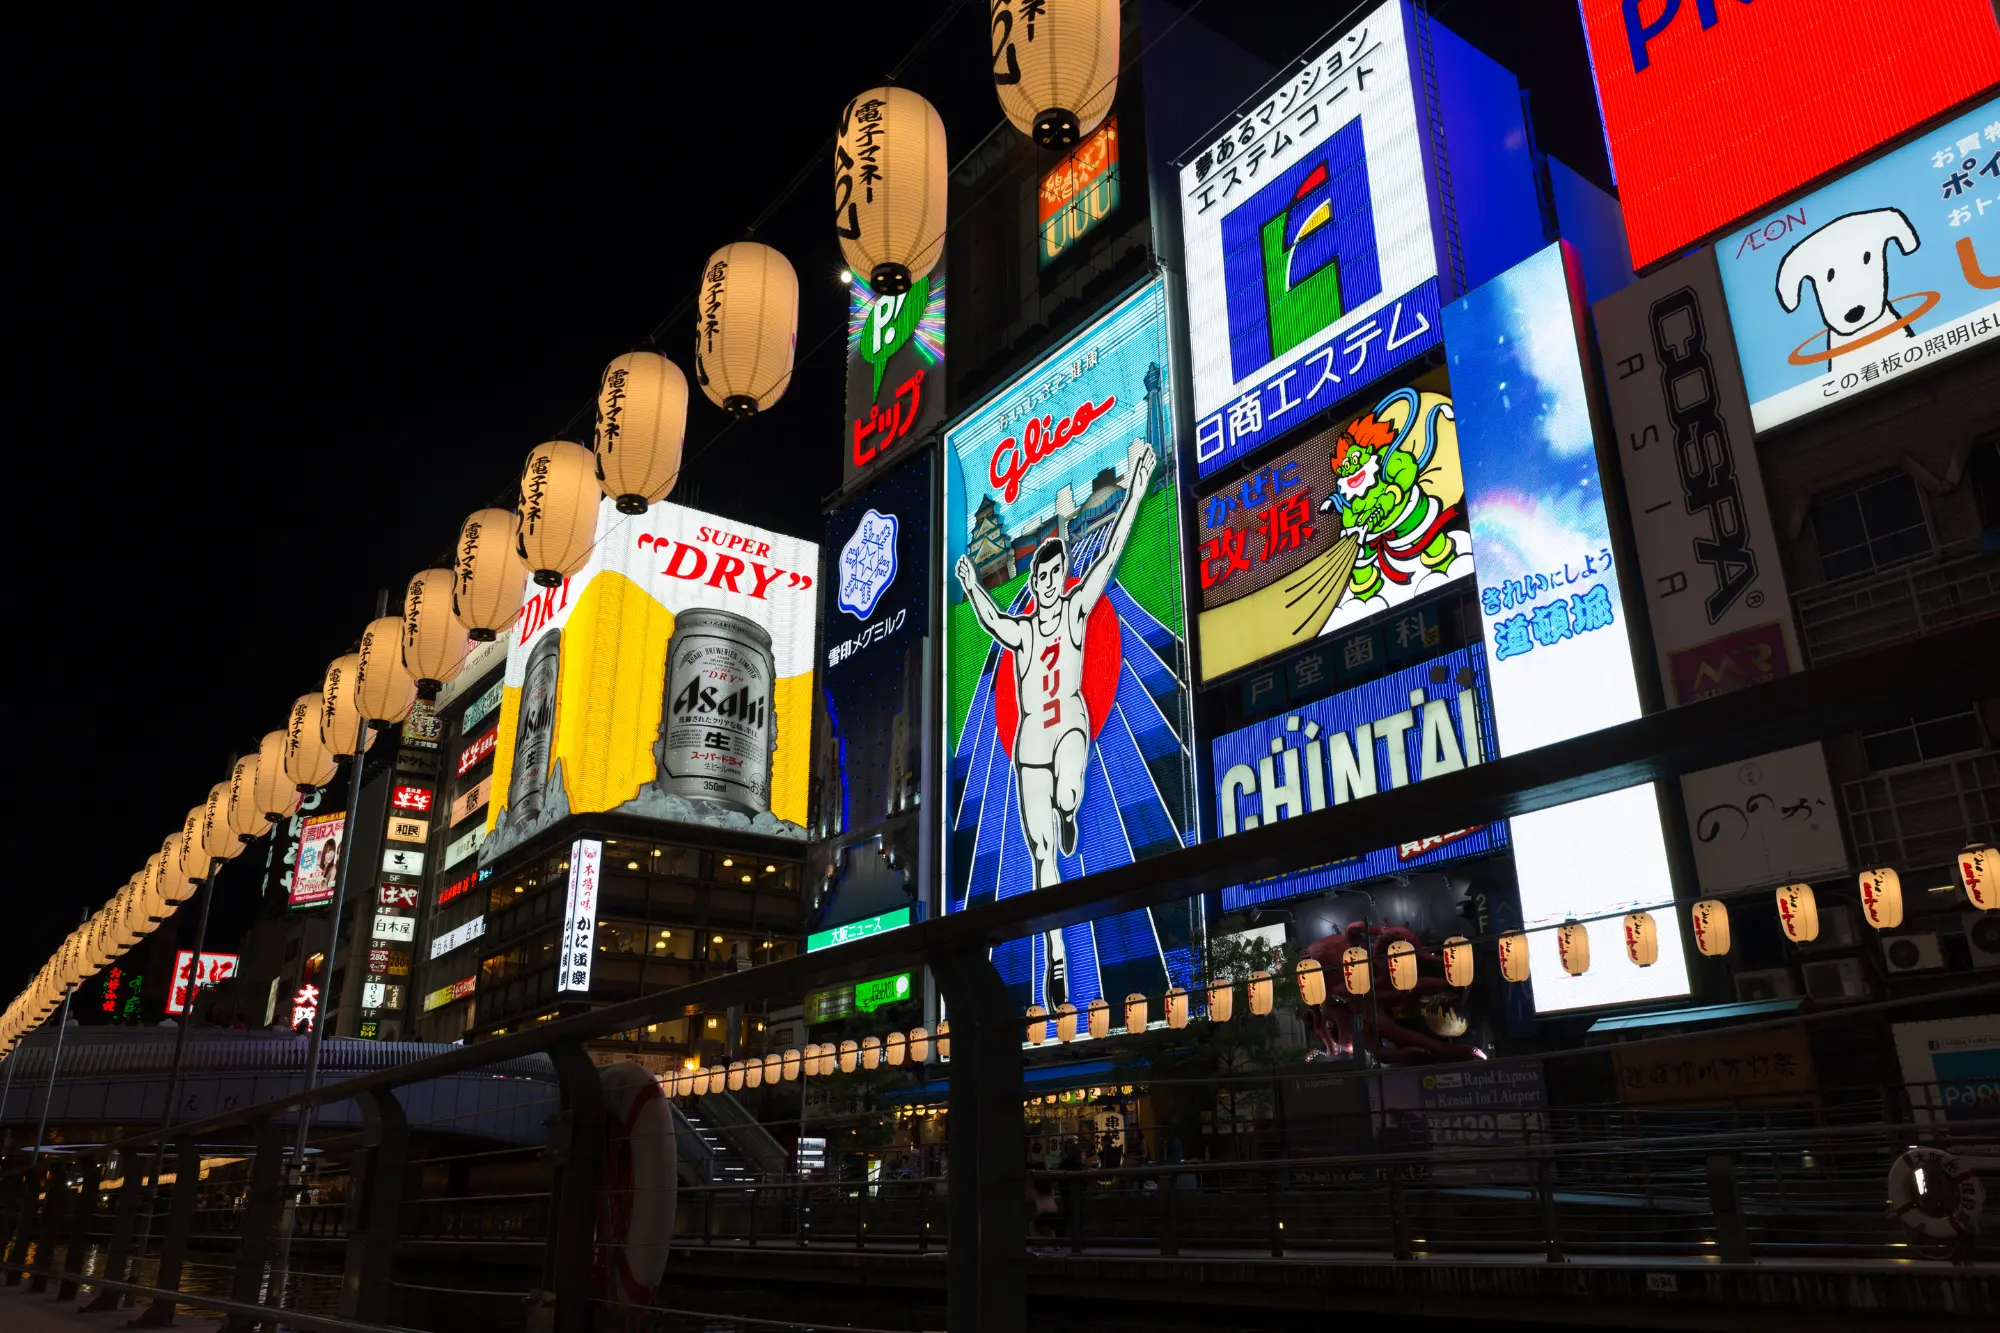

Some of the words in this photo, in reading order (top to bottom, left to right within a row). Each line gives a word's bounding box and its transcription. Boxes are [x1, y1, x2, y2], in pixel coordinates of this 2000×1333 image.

[1195, 27, 1368, 183] 夢あるマンション
[854, 98, 887, 204] 電子マネー
[1197, 65, 1374, 215] エステムコート
[703, 260, 728, 354] 電子マネー
[603, 368, 629, 454] 電子マネー
[997, 347, 1100, 431] おいしさと健康
[1195, 302, 1430, 464] 日商エステム
[853, 368, 925, 467] ピップ
[989, 394, 1116, 504] Glico
[1616, 352, 1688, 599] ASIA
[1648, 284, 1759, 626] COSPA
[527, 456, 551, 535] 電子マネー
[1204, 460, 1300, 529] かぜに
[460, 522, 482, 596] 電子マネー
[696, 525, 771, 559] SUPER
[1197, 487, 1316, 590] 改源
[407, 580, 425, 647] 電子マネー
[1481, 547, 1613, 617] きれいにしよう
[827, 608, 907, 668] 雪印メグミルク
[1494, 583, 1615, 662] 道頓堀
[357, 632, 375, 695] 電子マネー
[704, 646, 738, 661] BREWERIES
[739, 656, 758, 680] LIMITED
[1039, 636, 1062, 730] グリコ
[325, 667, 342, 728] 電子マネー
[674, 674, 765, 731] Asahi
[290, 703, 307, 758] 電子マネー
[690, 750, 744, 768] スーパードライ
[704, 731, 732, 752] 生
[703, 780, 727, 793] 350ml
[306, 823, 336, 842] 高収入
[396, 823, 420, 836] 和民
[380, 886, 418, 906] はや
[389, 874, 400, 882] 5F
[579, 862, 597, 911] 本場の味
[376, 919, 411, 935] 白木屋
[377, 907, 391, 915] 4F
[831, 917, 882, 944] 大阪ニュース
[1425, 1099, 1436, 1108] to
[1438, 1091, 1473, 1108] Kansai
[1501, 1088, 1541, 1107] Airport
[1464, 1071, 1495, 1090] Rapid
[1499, 1068, 1538, 1088] Express
